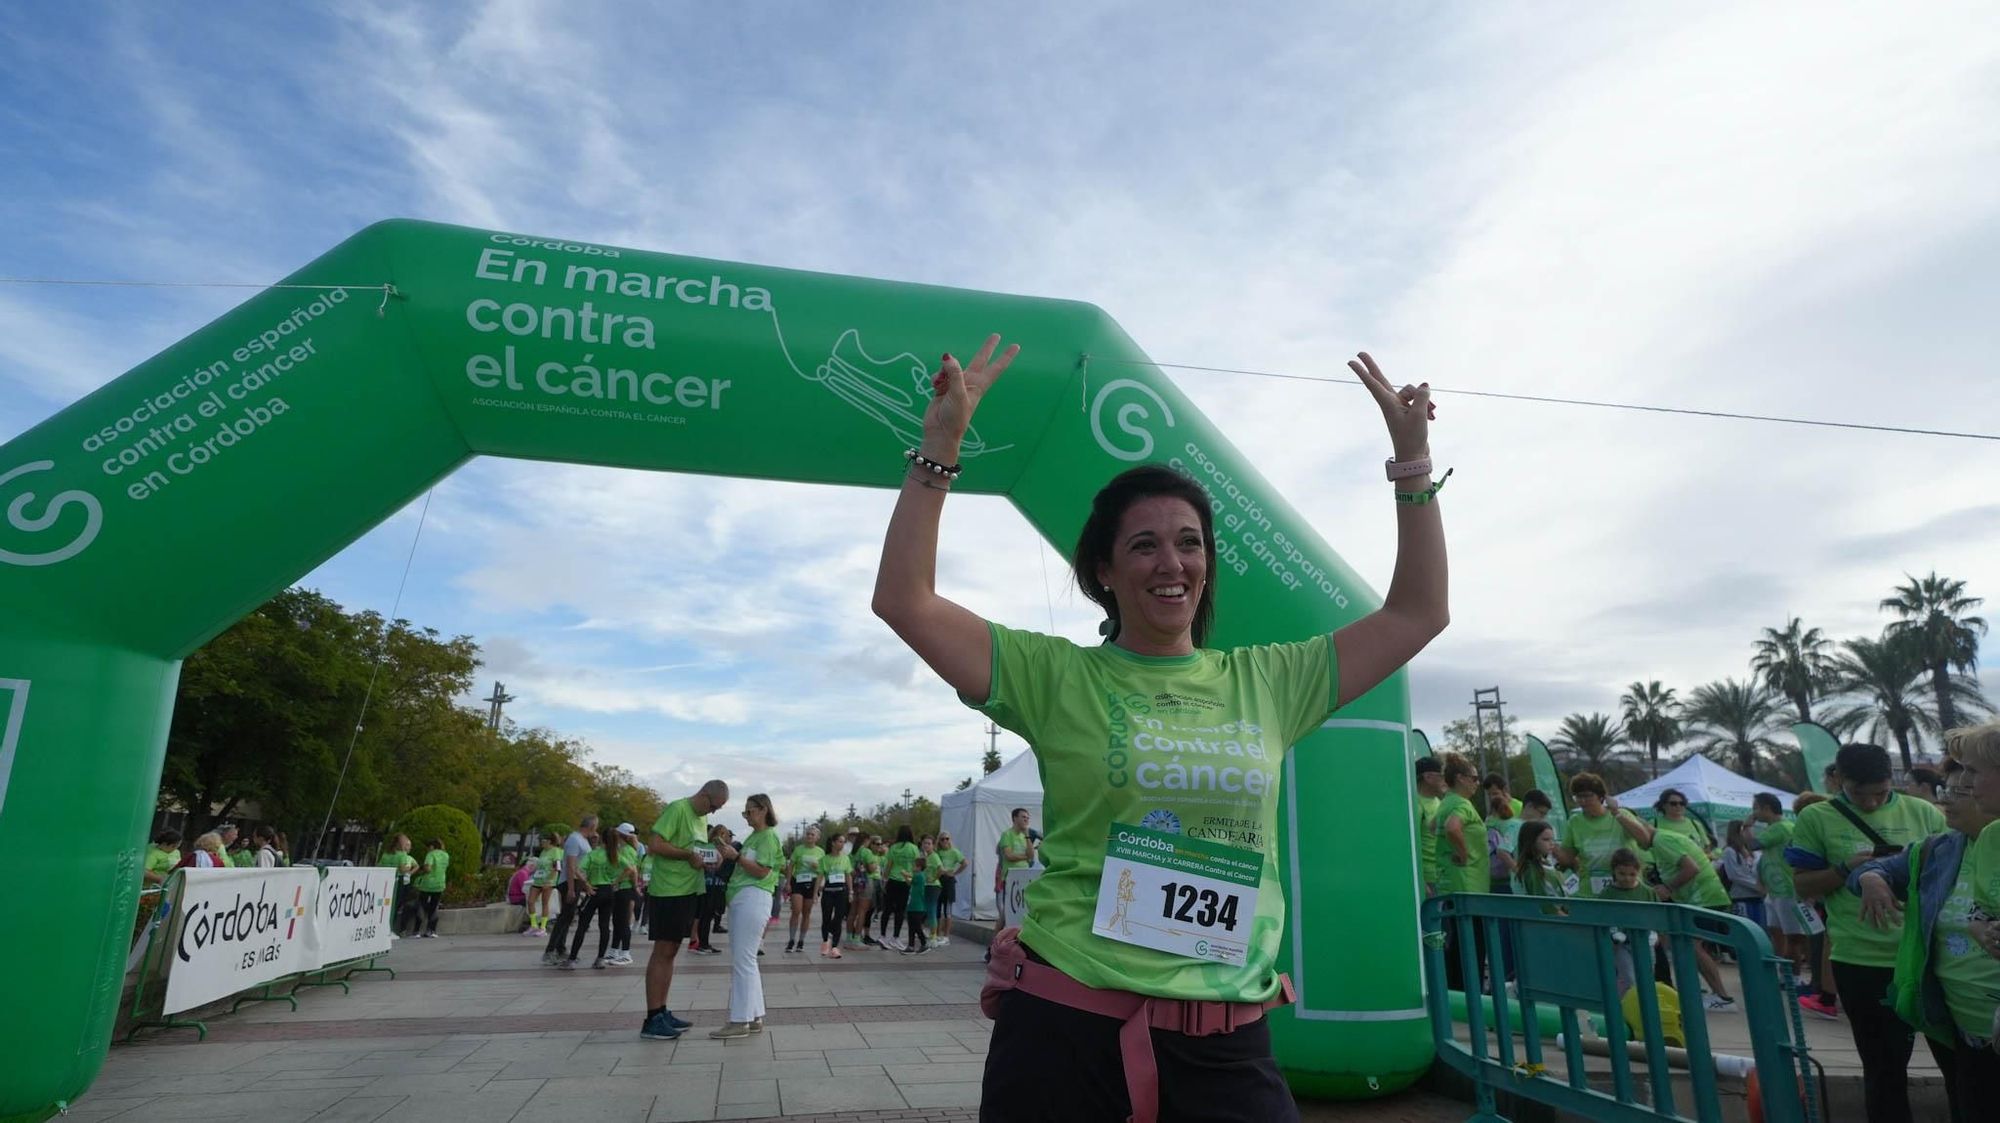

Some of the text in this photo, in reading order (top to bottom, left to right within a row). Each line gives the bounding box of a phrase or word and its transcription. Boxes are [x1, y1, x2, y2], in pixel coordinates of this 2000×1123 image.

[476, 248, 773, 312] En marcha
[466, 299, 656, 350] contra
[83, 287, 349, 452] asociación española
[466, 345, 731, 410] el cáncer
[102, 337, 318, 475] contra el cáncer
[472, 397, 535, 411] ASOCIACIÓN
[537, 403, 590, 416] ESPAÑOLA
[591, 408, 632, 420] CONTRA
[633, 412, 646, 421] EL
[127, 397, 290, 500] en Córdoba
[1185, 442, 1349, 609] asociación española
[1224, 514, 1246, 533] el
[1242, 532, 1303, 591] cáncer
[1134, 733, 1244, 757] contra
[1118, 831, 1174, 853] Córdoba
[1210, 856, 1231, 866] contra
[1131, 849, 1161, 861] MARCHA
[1172, 859, 1204, 871] CARRERA
[1204, 866, 1226, 875] Contra
[1161, 882, 1239, 932] 1234
